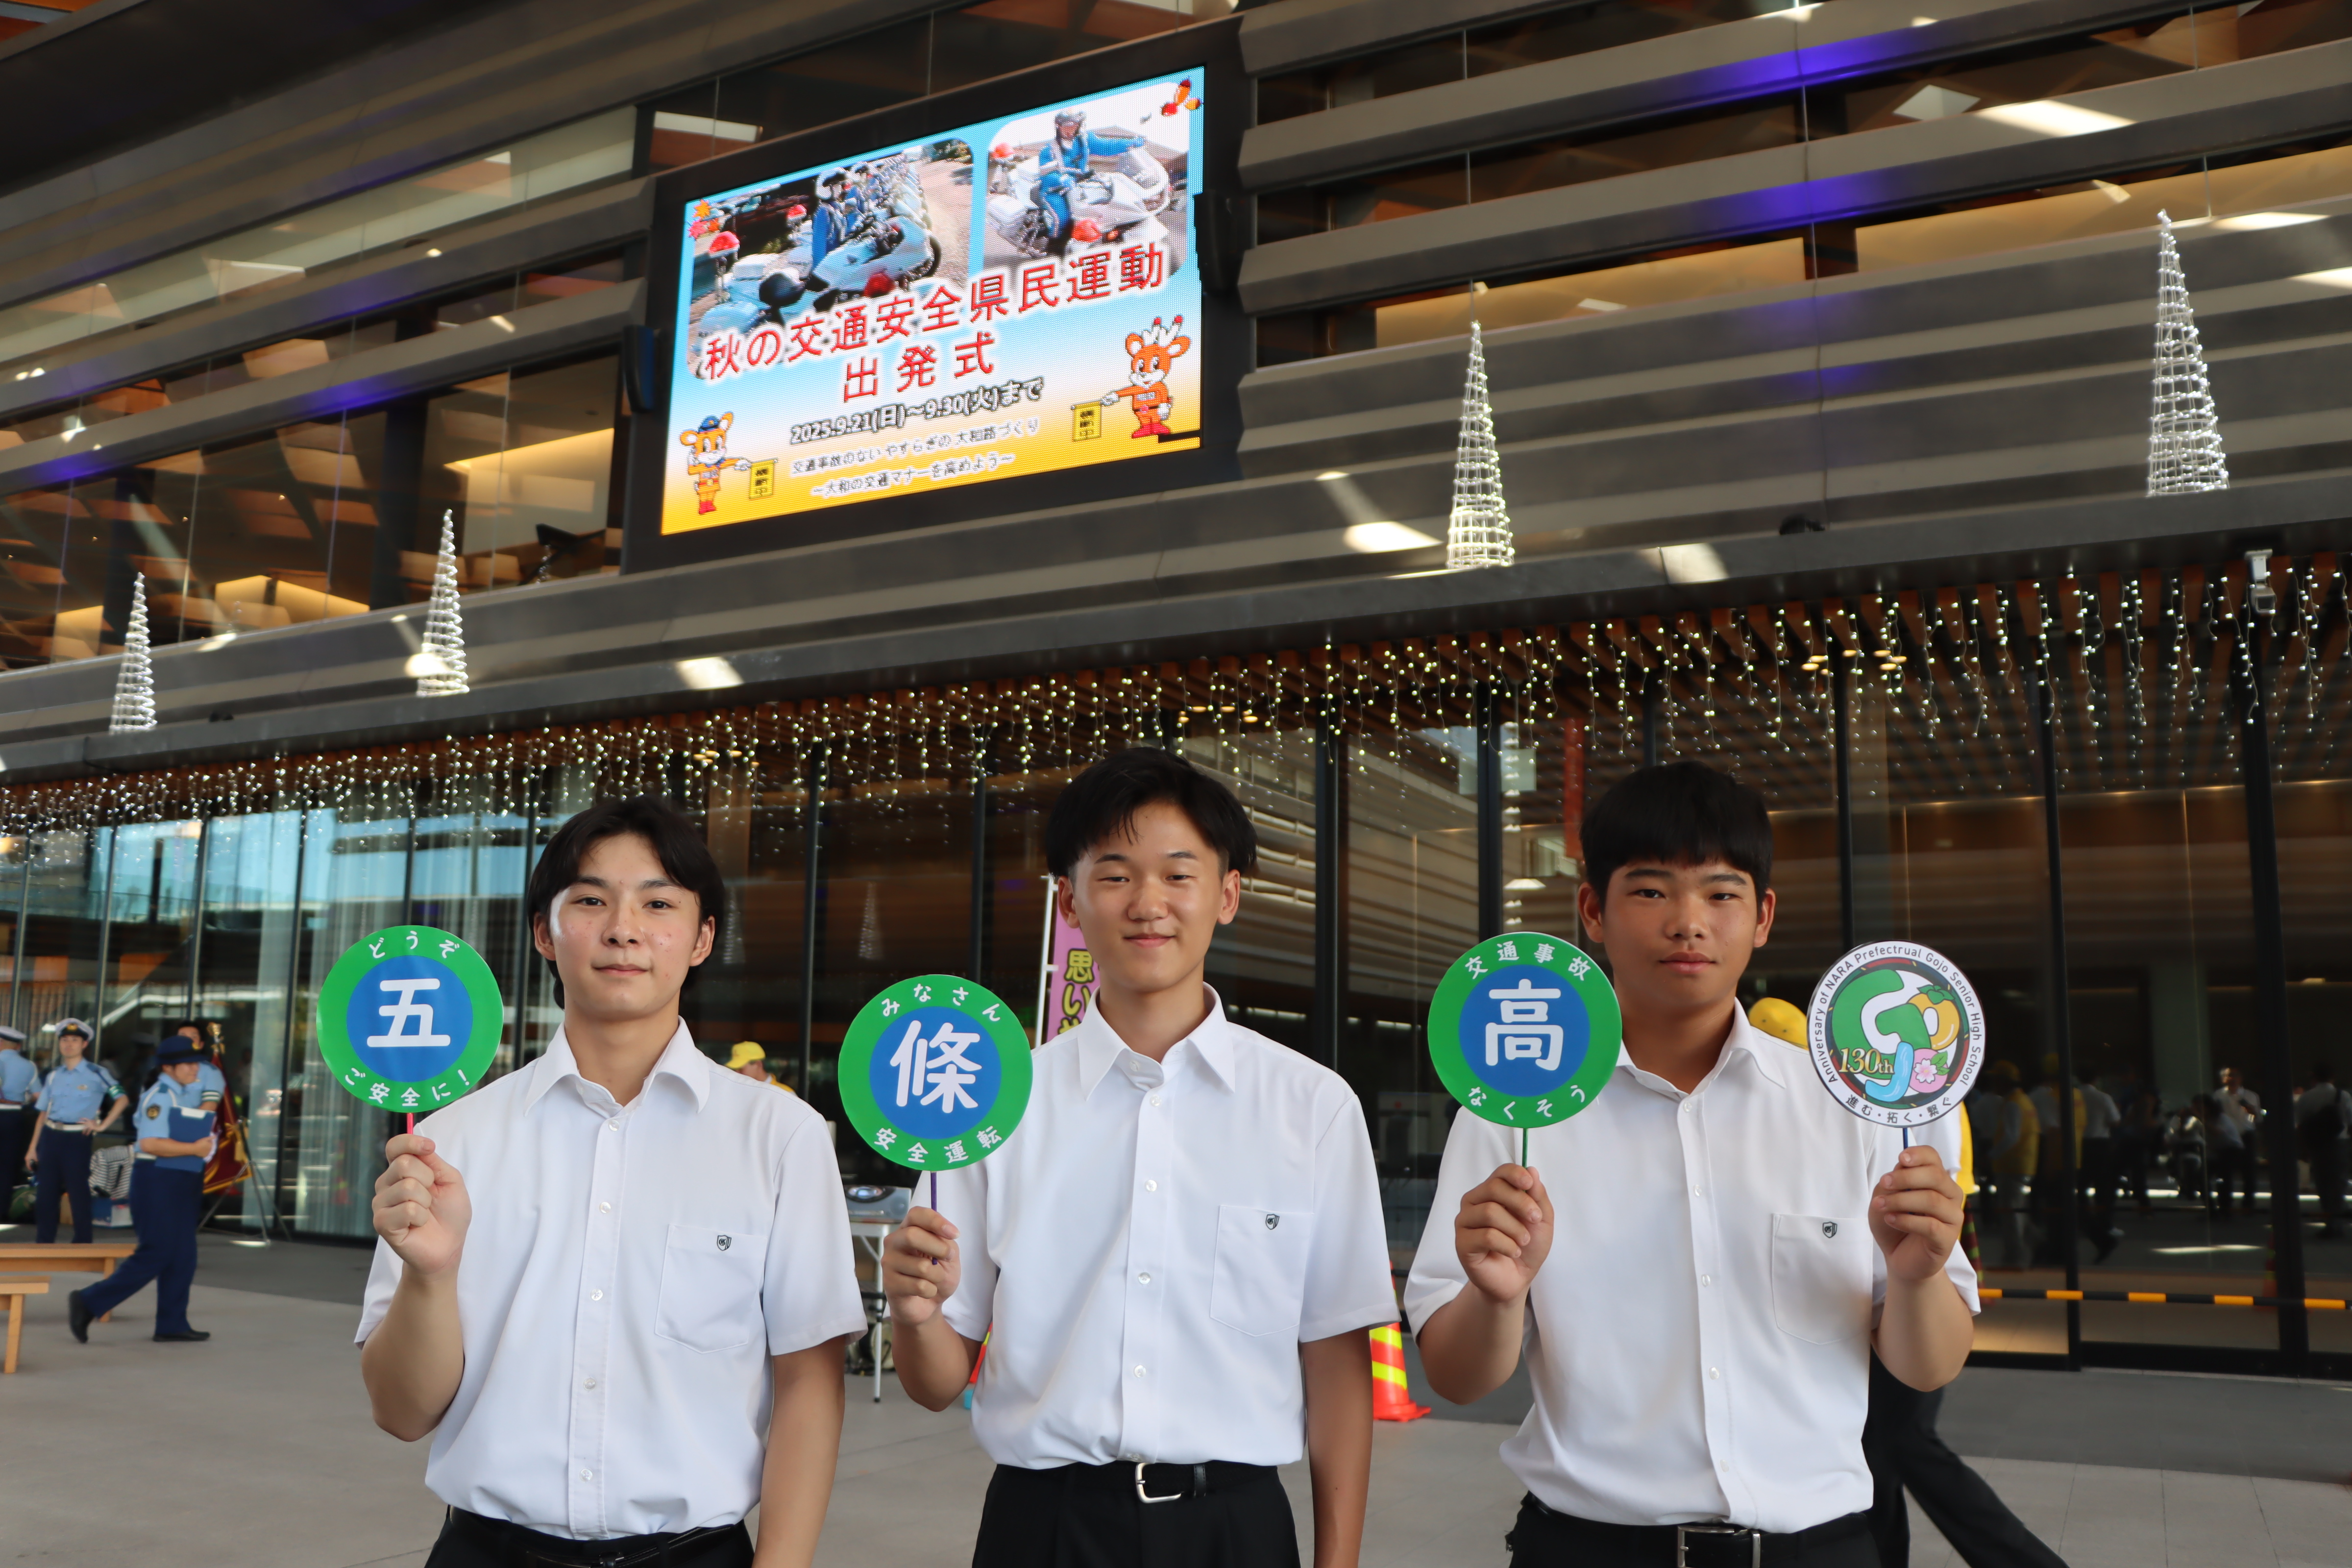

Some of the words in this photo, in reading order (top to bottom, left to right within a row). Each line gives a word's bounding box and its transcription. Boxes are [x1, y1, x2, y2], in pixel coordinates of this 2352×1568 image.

[706, 243, 1163, 379] 秋の交通安全県民運動
[843, 332, 995, 403] 出発式
[368, 931, 460, 958] どうぞ
[1465, 940, 1591, 980] 交通事故
[1854, 945, 1922, 964] Prefectrual
[1926, 952, 1949, 974] Gojo
[1825, 960, 1854, 989] NARA
[1950, 972, 1975, 1008] Senior
[367, 978, 451, 1048] 五
[882, 983, 1000, 1022] みなさん
[1819, 991, 1830, 1004] of
[1486, 979, 1564, 1071] 高
[1970, 1012, 1983, 1041] High
[1814, 1008, 1838, 1084] Anniversary
[1838, 1047, 1895, 1075] 130th
[890, 1020, 982, 1113] 條
[1960, 1046, 1982, 1086] School
[1468, 1085, 1586, 1120] なくそう
[874, 1126, 1002, 1163] 安全運転
